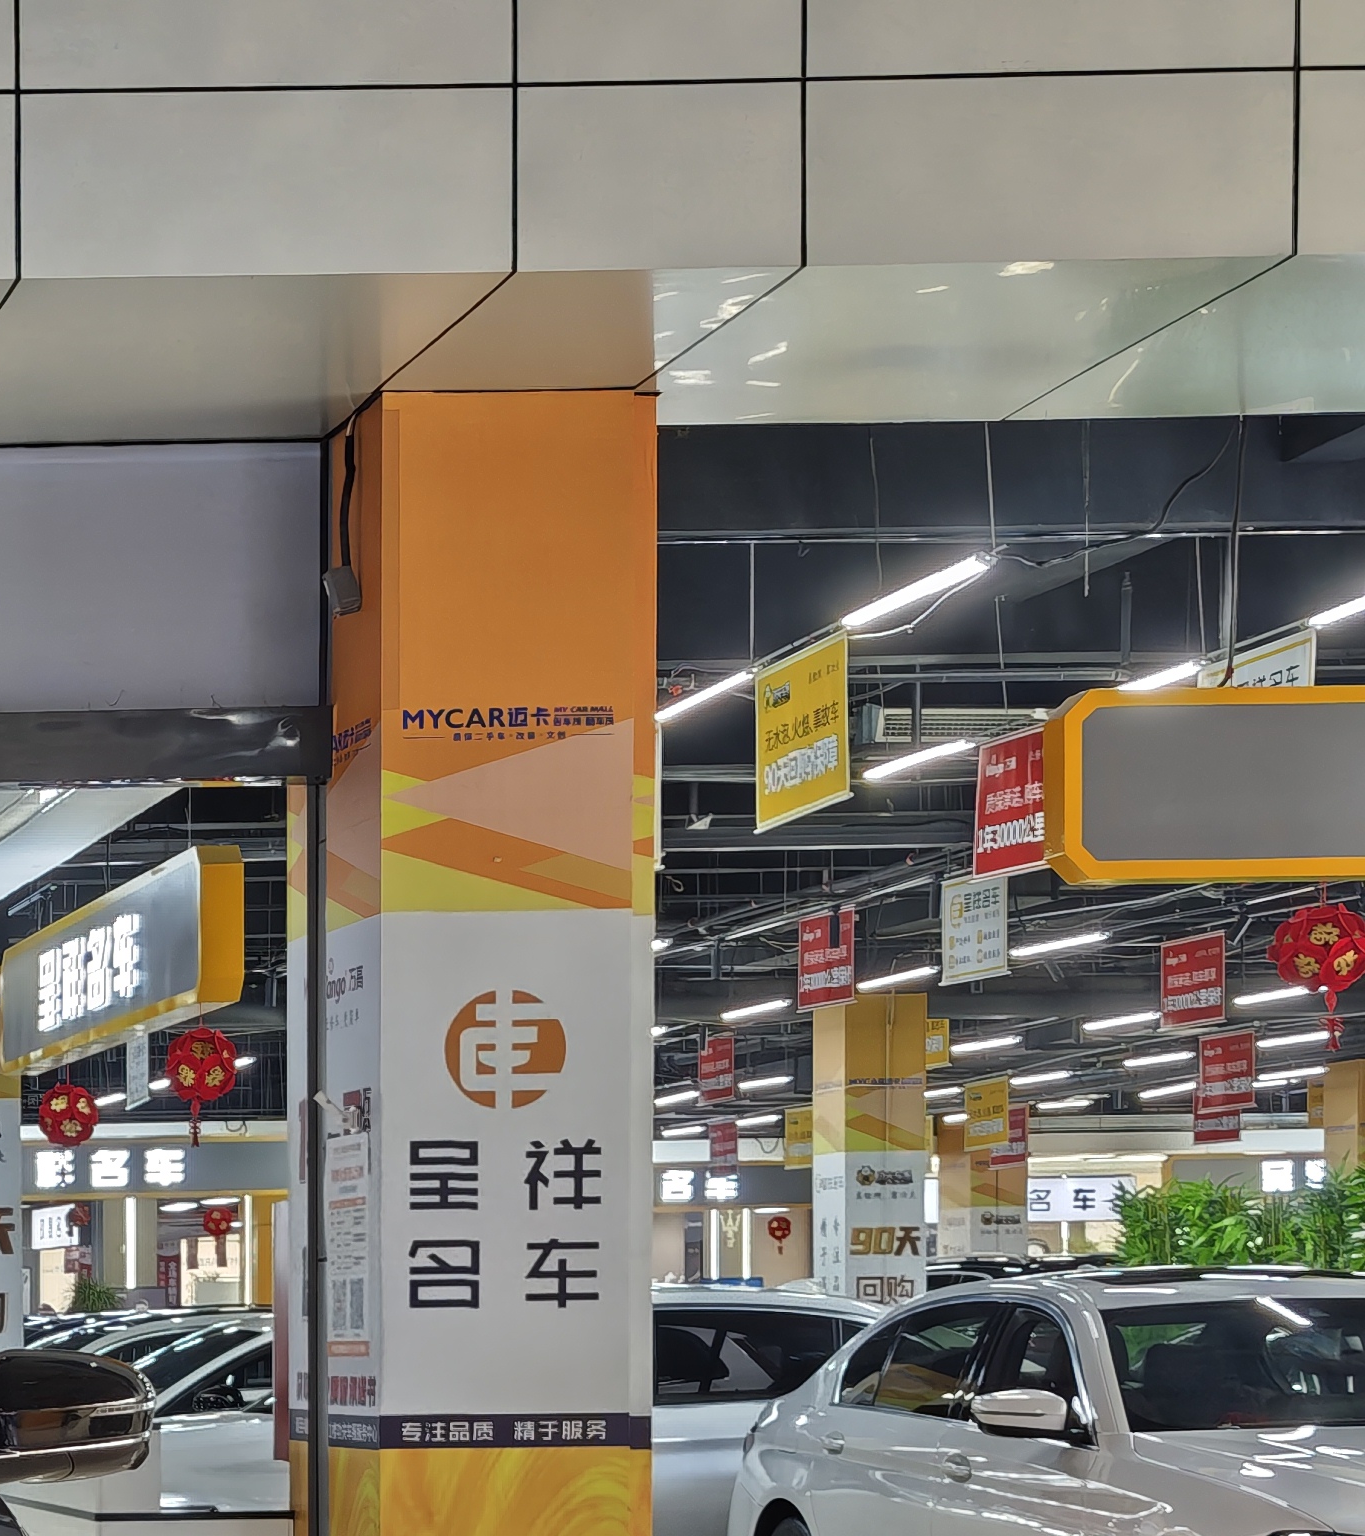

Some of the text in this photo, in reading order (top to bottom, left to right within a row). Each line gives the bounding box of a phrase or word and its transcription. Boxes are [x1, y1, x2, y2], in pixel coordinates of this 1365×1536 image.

[409, 1138, 602, 1211] 呈祥
[1029, 1188, 1096, 1212] 名车
[849, 1226, 921, 1256] 90天
[409, 1237, 600, 1310] 名车
[856, 1274, 915, 1305] 回购
[401, 1419, 608, 1442] 专注品质 精于服务
